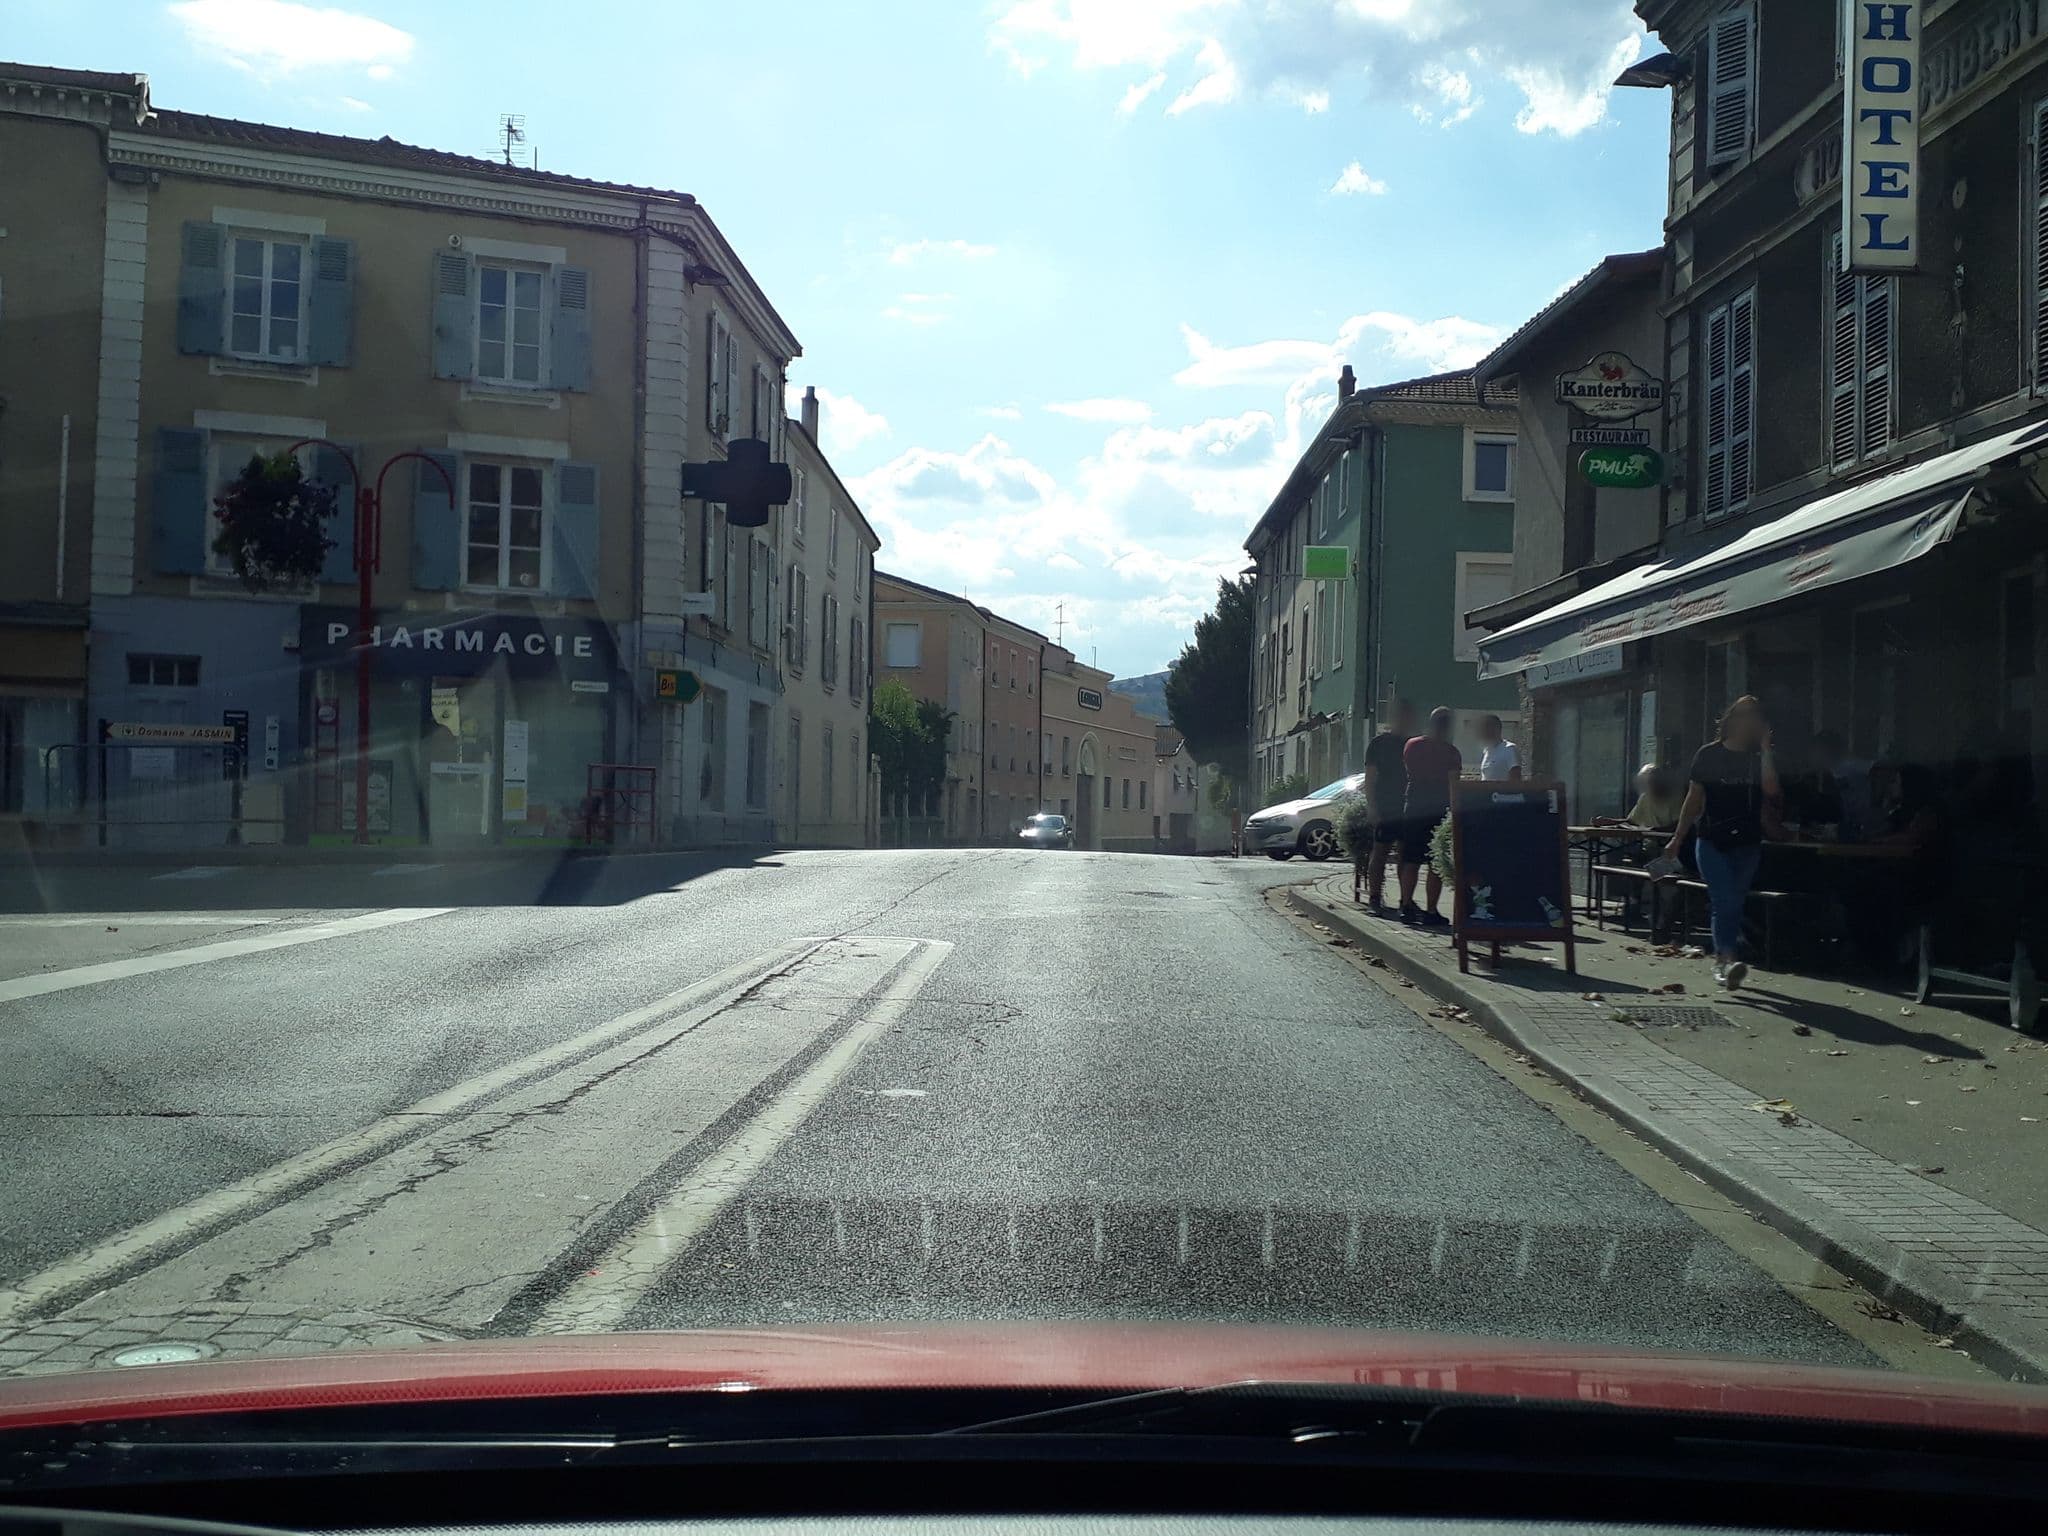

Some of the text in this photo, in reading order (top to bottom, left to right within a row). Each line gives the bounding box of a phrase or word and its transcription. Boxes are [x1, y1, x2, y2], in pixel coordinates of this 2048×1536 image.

[1860, 3, 1912, 250] HOTEL
[1563, 381, 1660, 399] Kanterbräu
[1575, 430, 1644, 443] RESTAURANT
[1588, 458, 1627, 475] PMU
[327, 622, 593, 657] PHARMACIE
[138, 726, 231, 739] Domaine JASMIN
